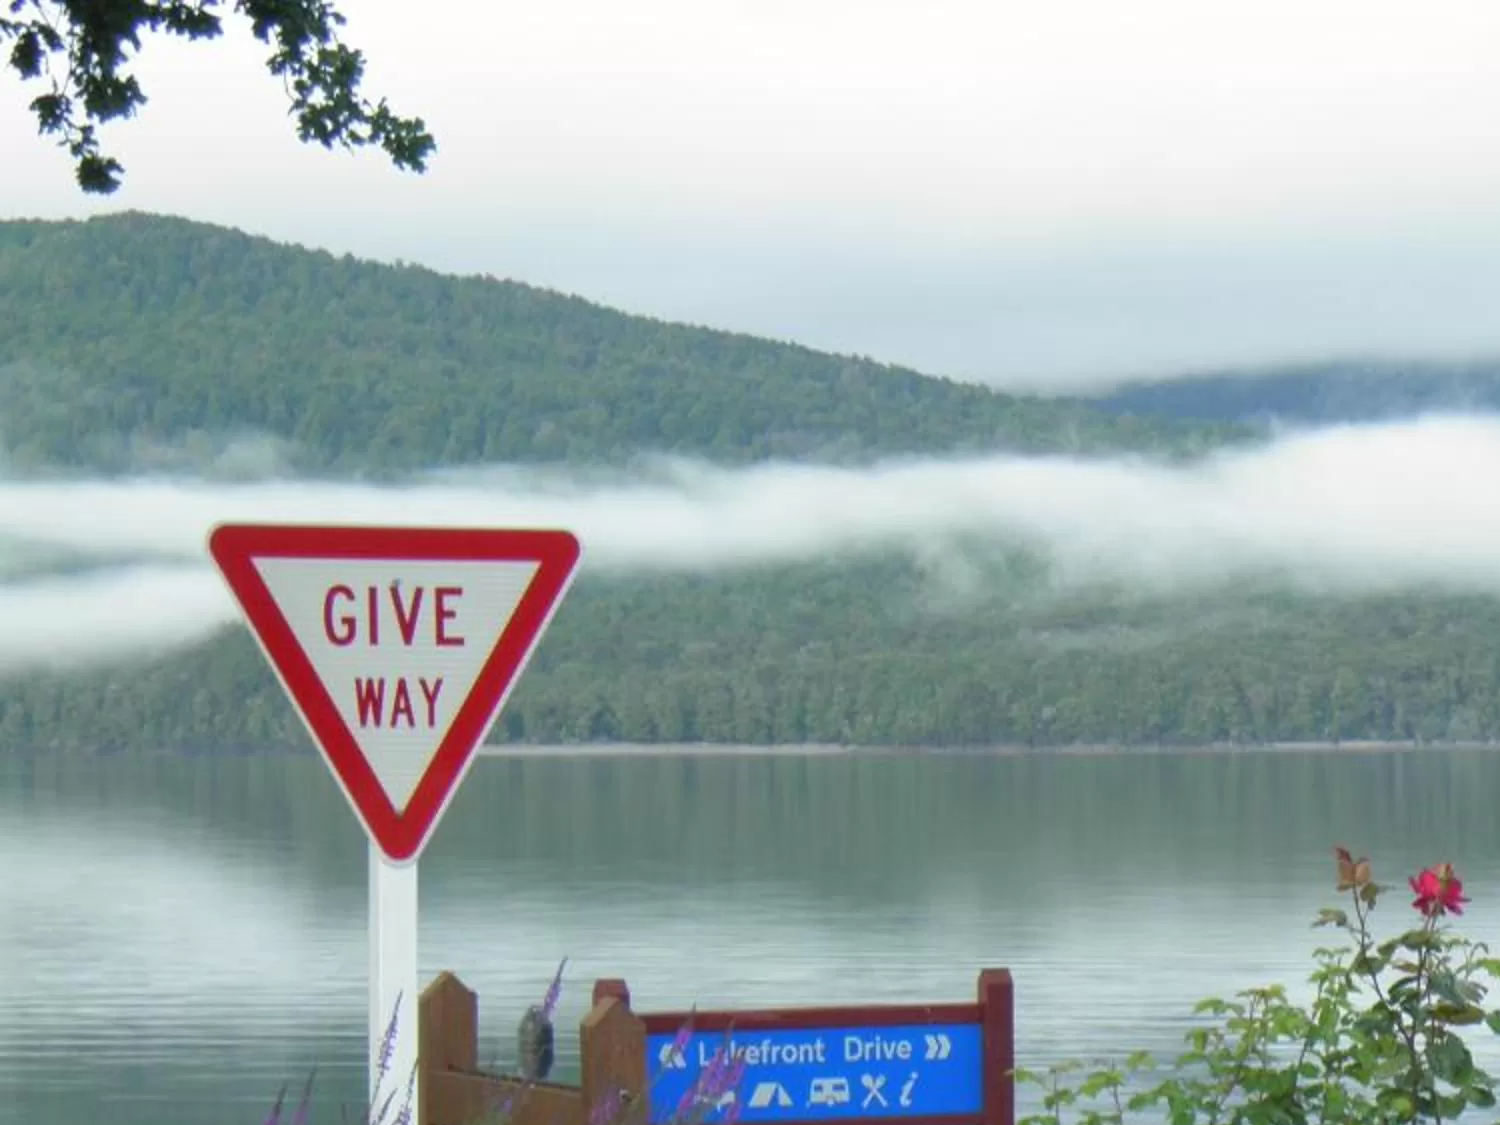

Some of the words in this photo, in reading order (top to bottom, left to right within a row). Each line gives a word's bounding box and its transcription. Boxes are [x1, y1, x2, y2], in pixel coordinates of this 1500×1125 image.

[323, 584, 465, 647] GIVE
[355, 677, 444, 728] WAY
[844, 1035, 912, 1063] Drive
